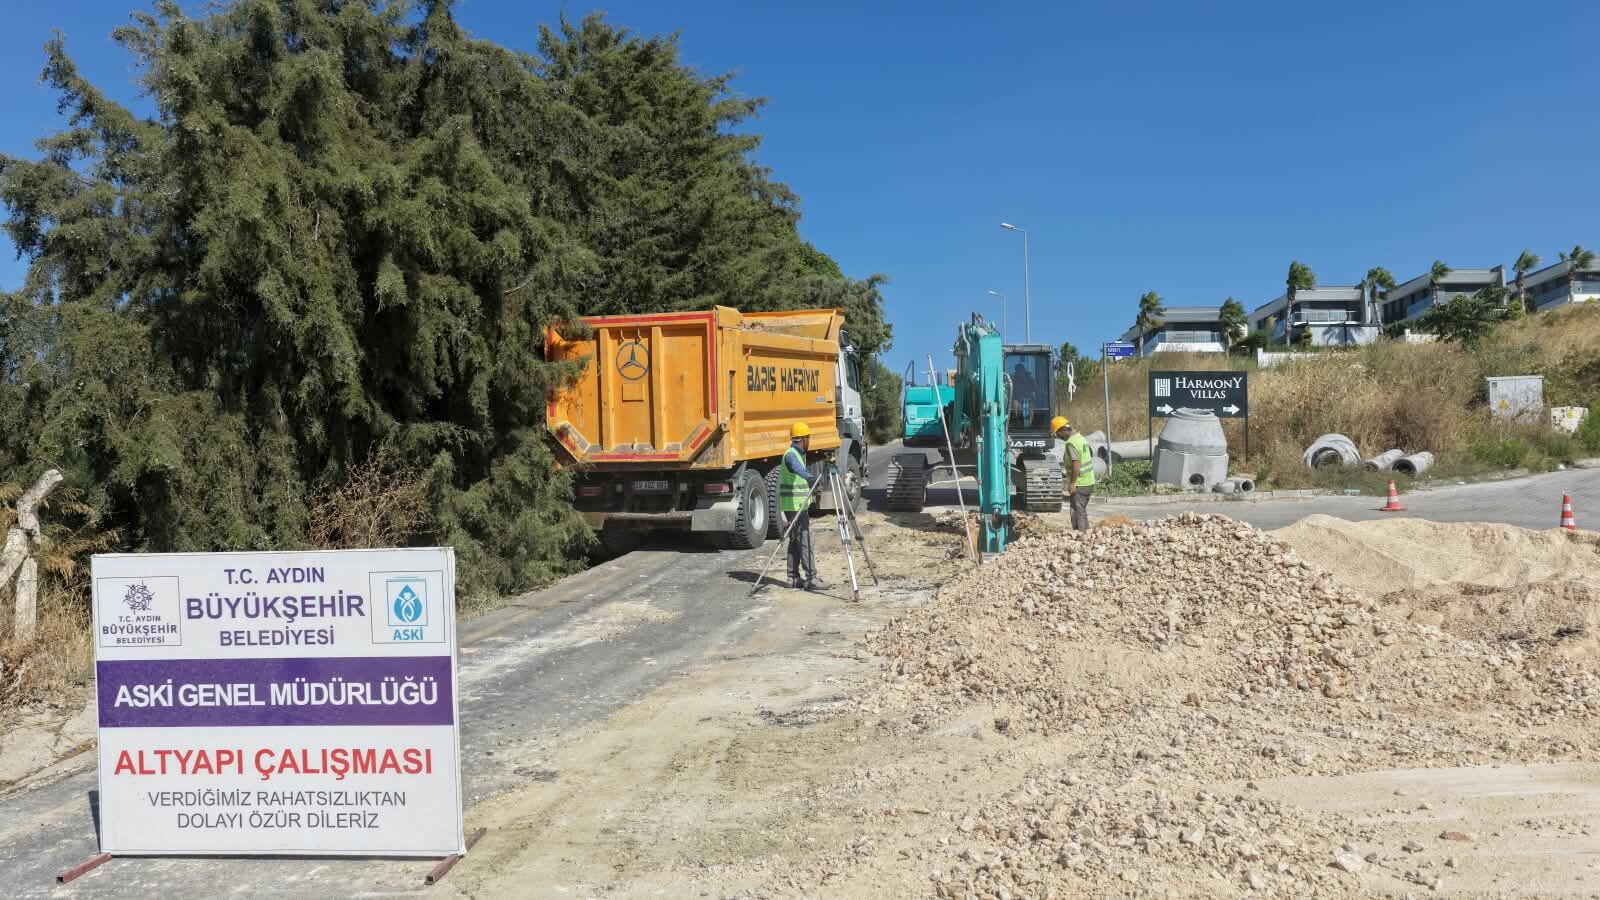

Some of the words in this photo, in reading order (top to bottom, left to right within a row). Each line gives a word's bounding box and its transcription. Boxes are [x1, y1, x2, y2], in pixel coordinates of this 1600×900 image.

[1190, 389, 1227, 399] VILLAS
[223, 568, 259, 585] T.C.
[266, 566, 325, 584] AYDIN
[185, 590, 366, 623] BÜYÜKŞEHİR
[135, 615, 161, 623] AYDIN
[102, 622, 177, 636] BÜYÜKŞEHİR
[219, 626, 335, 647] BELEDİYESİ
[392, 628, 424, 641] ASKİ
[116, 635, 165, 644] BELEDİYESİ
[113, 679, 174, 707] ASKİ
[178, 683, 266, 707] GENEL
[270, 676, 438, 706] MÜDÜRLÜĞÜ
[114, 748, 244, 776] ALTYAPI
[254, 748, 432, 780] ÇALIŞMASI
[147, 788, 252, 807] VERDİĞİMİZ
[256, 790, 406, 807] RAHATSIZLIKTAN
[177, 813, 243, 829] DOLAYI
[248, 809, 302, 829] ÖZÜR
[307, 809, 380, 829] DİLERİZ
